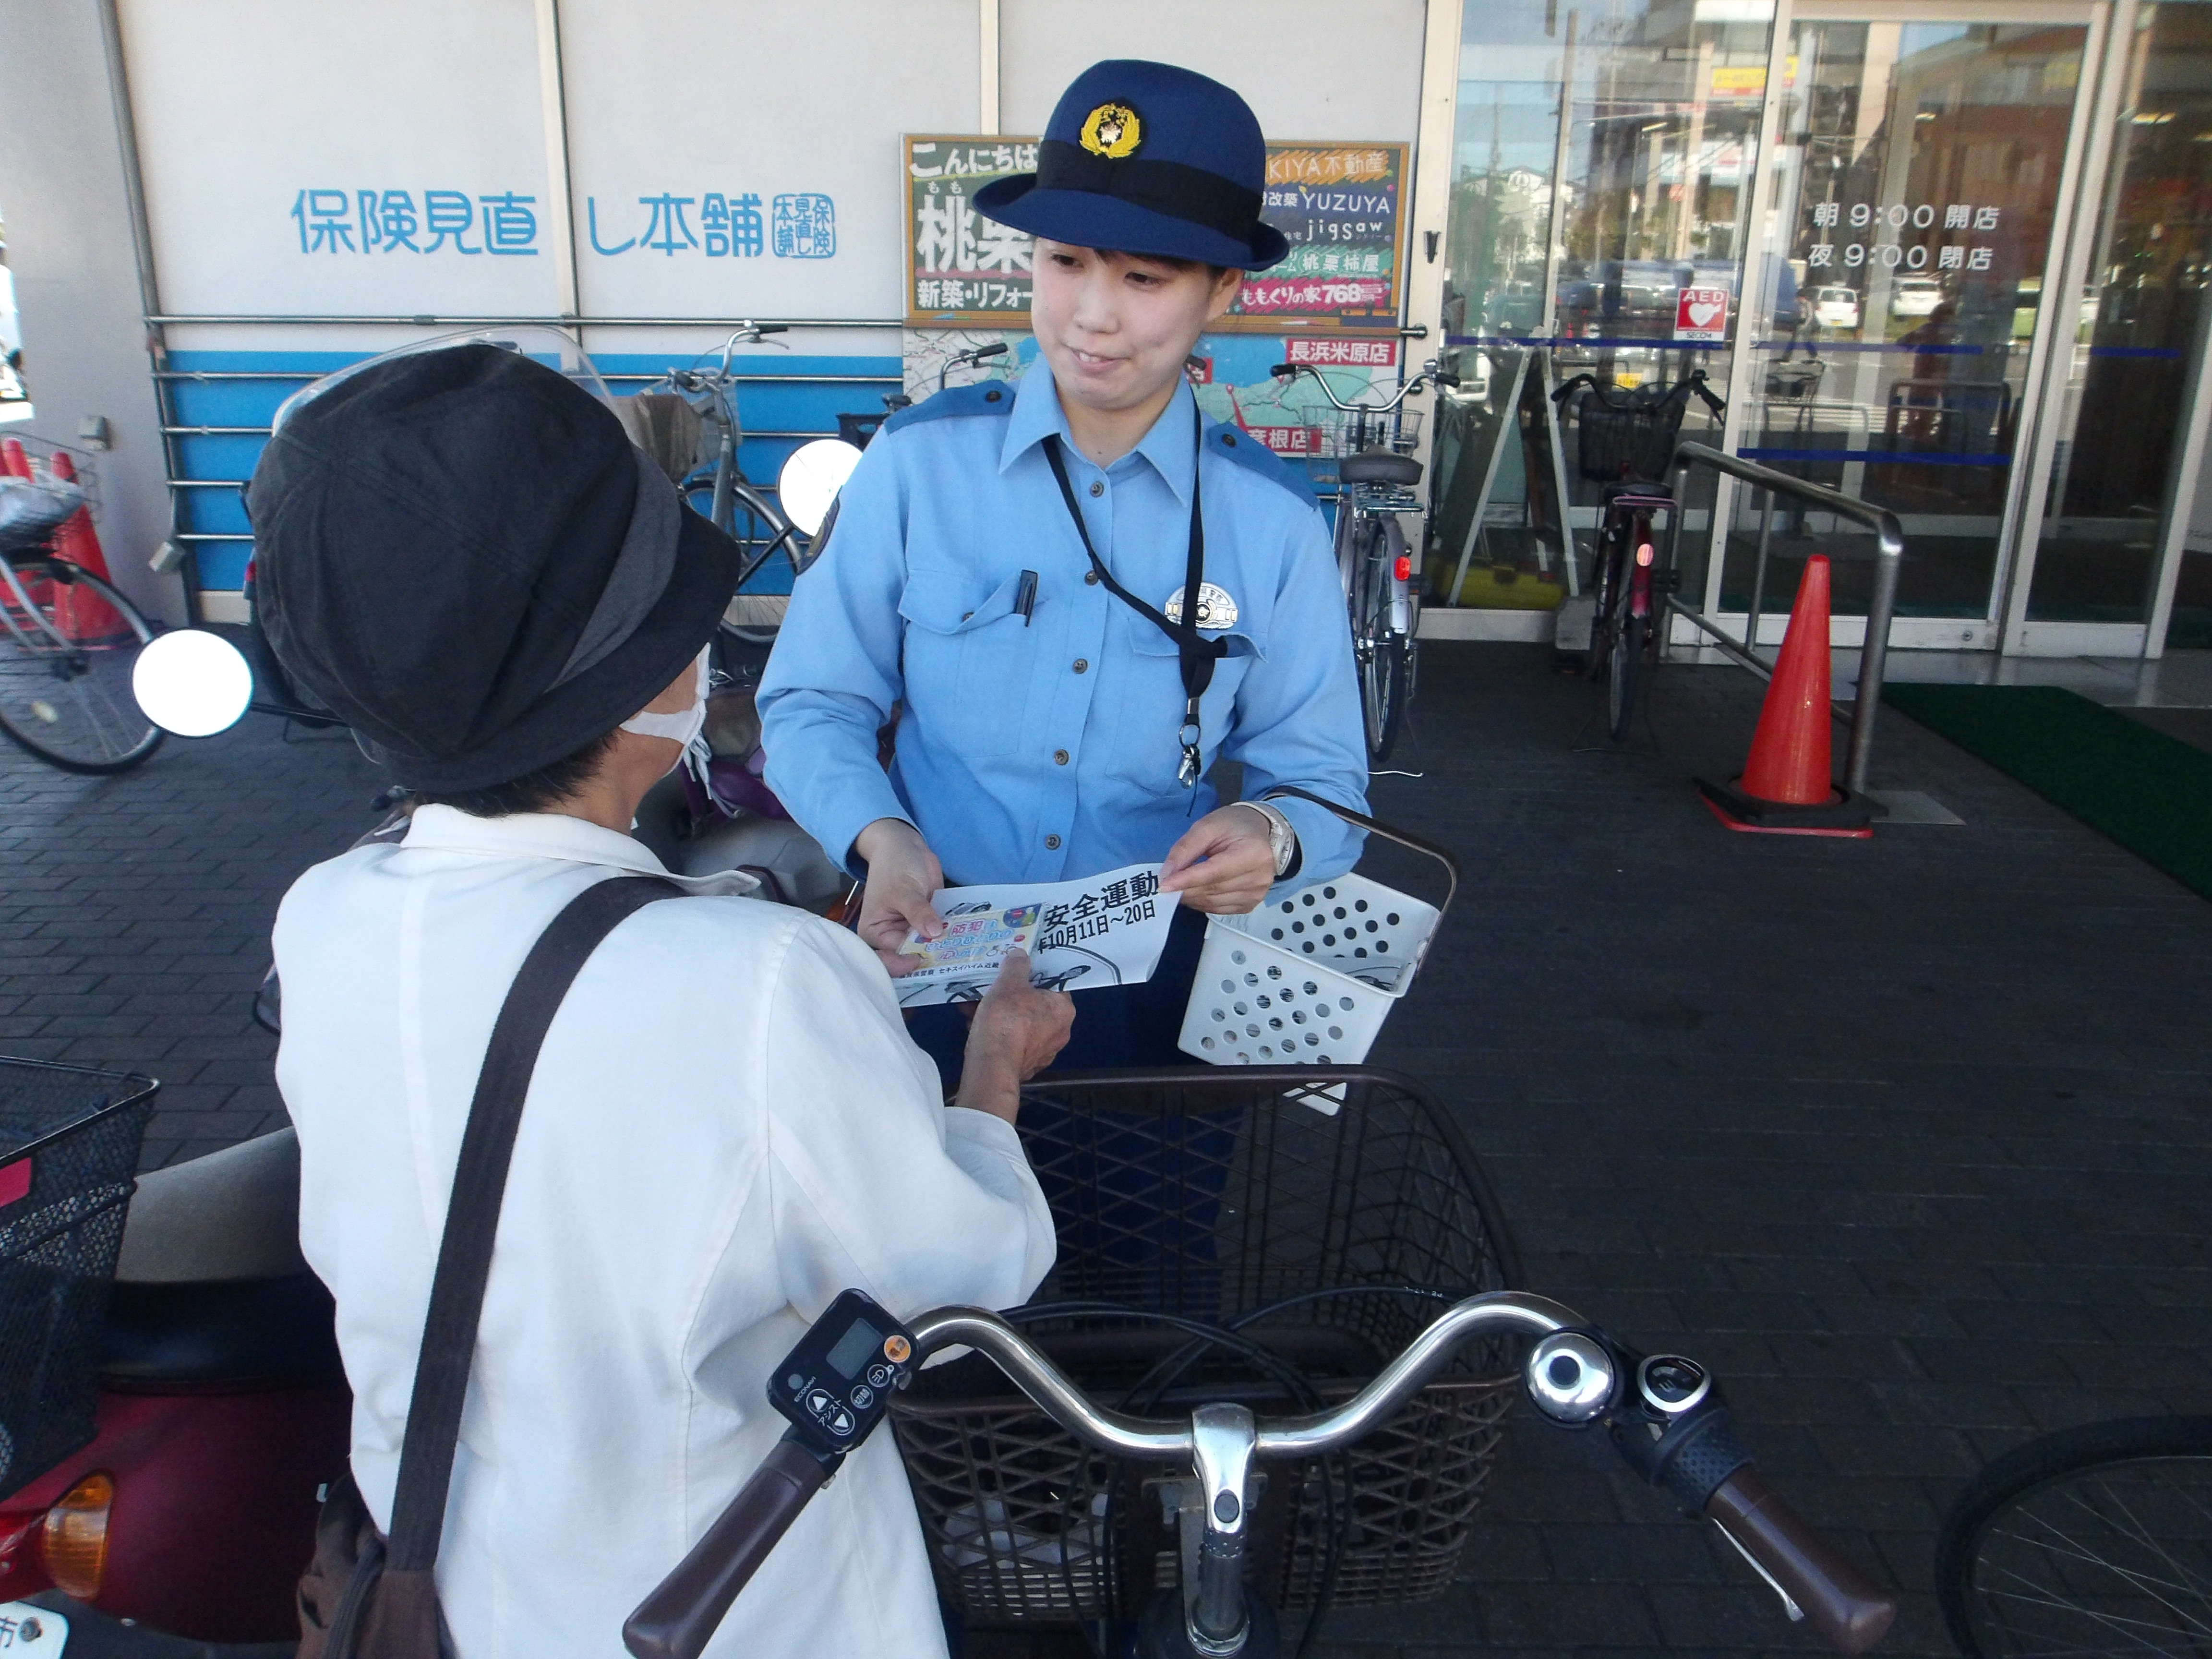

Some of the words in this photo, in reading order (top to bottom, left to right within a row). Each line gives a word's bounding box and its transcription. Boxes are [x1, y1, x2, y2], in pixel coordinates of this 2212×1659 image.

[910, 142, 1039, 177] こんにちは
[1303, 192, 1390, 214] YUZUYA
[1813, 202, 1839, 227] 朝
[1849, 203, 1935, 229] 9:00
[1944, 204, 2001, 231] 開店
[1306, 219, 1383, 241] jigsaw
[1808, 243, 1835, 267] 夜
[1844, 243, 1928, 269] 9:00
[1937, 245, 1994, 271] 閉店
[1683, 290, 1724, 302] AED
[1290, 341, 1390, 363] 長浜米原店
[1044, 870, 1160, 934] 安全運動
